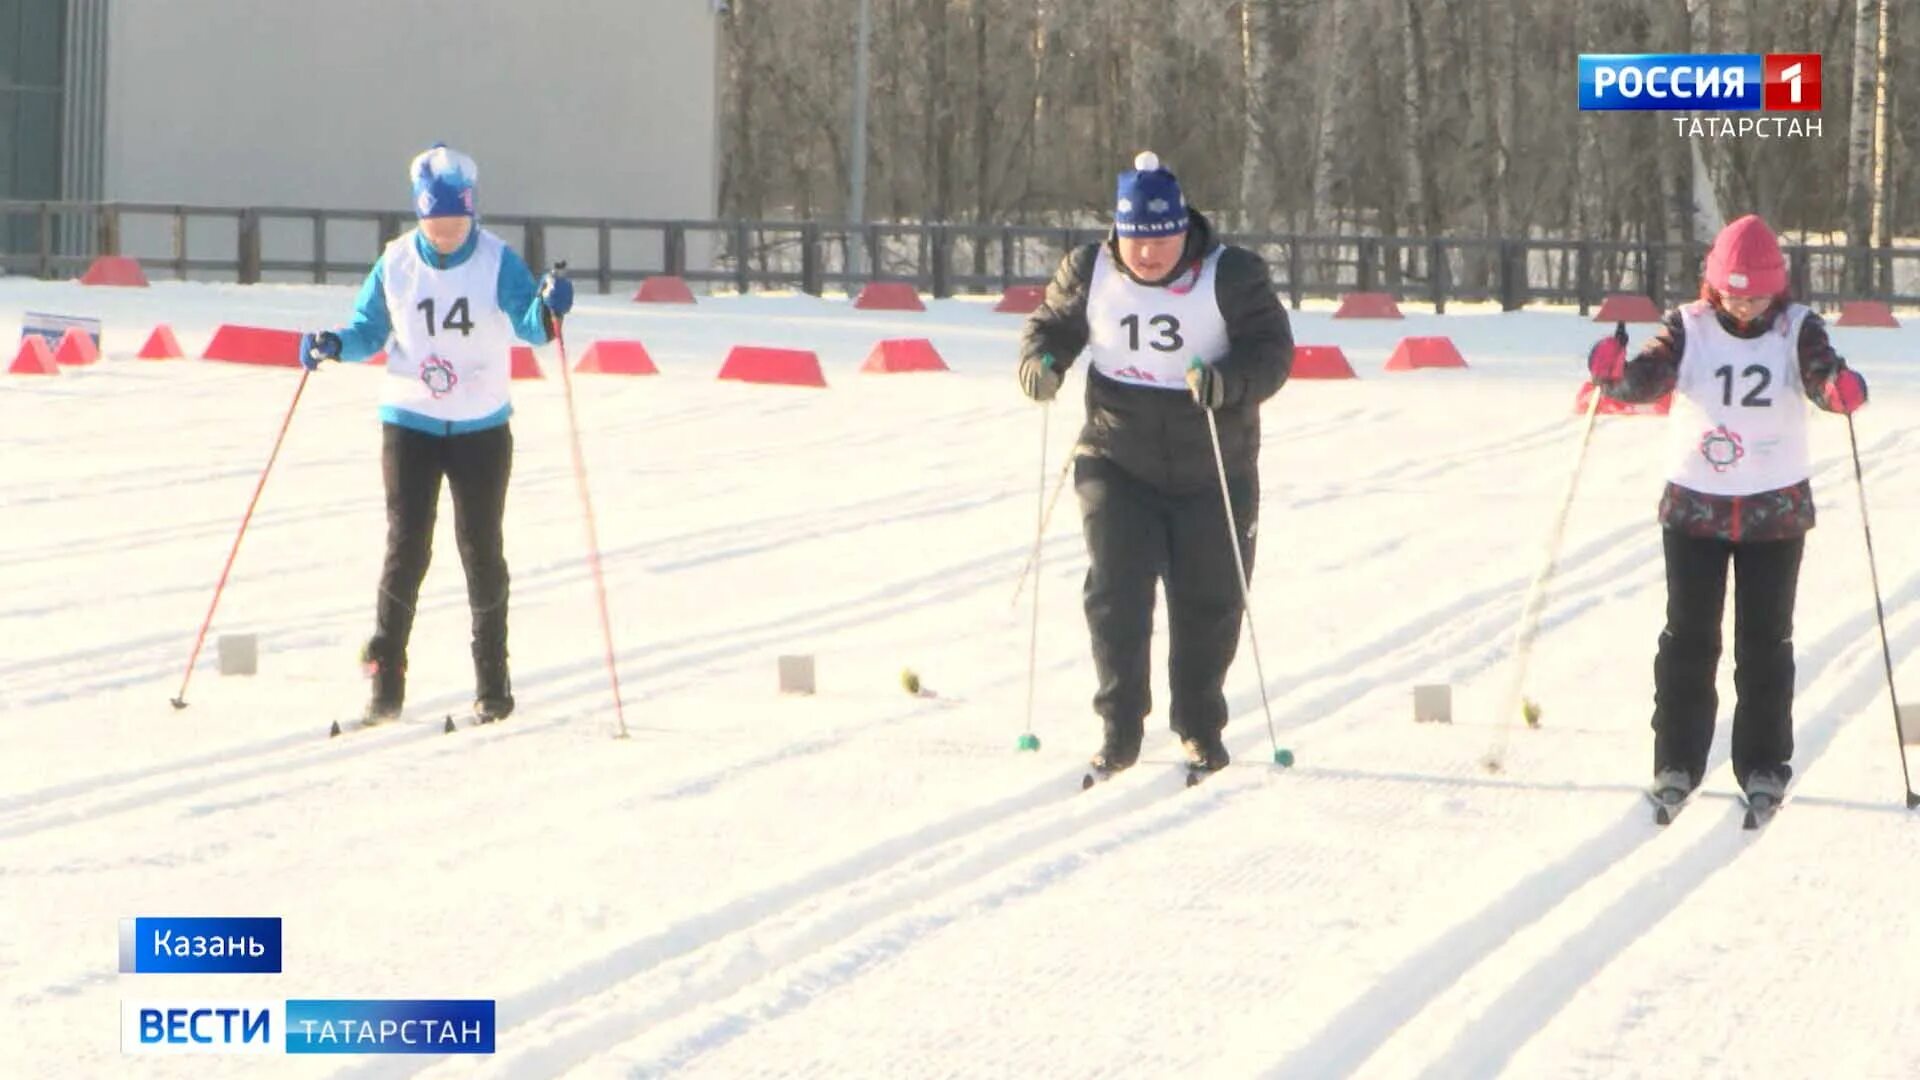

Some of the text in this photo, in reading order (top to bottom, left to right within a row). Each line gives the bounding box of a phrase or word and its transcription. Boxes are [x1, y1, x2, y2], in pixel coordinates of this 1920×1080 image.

[416, 296, 475, 337] 14
[1119, 313, 1184, 352] 13
[1714, 363, 1773, 407] 12
